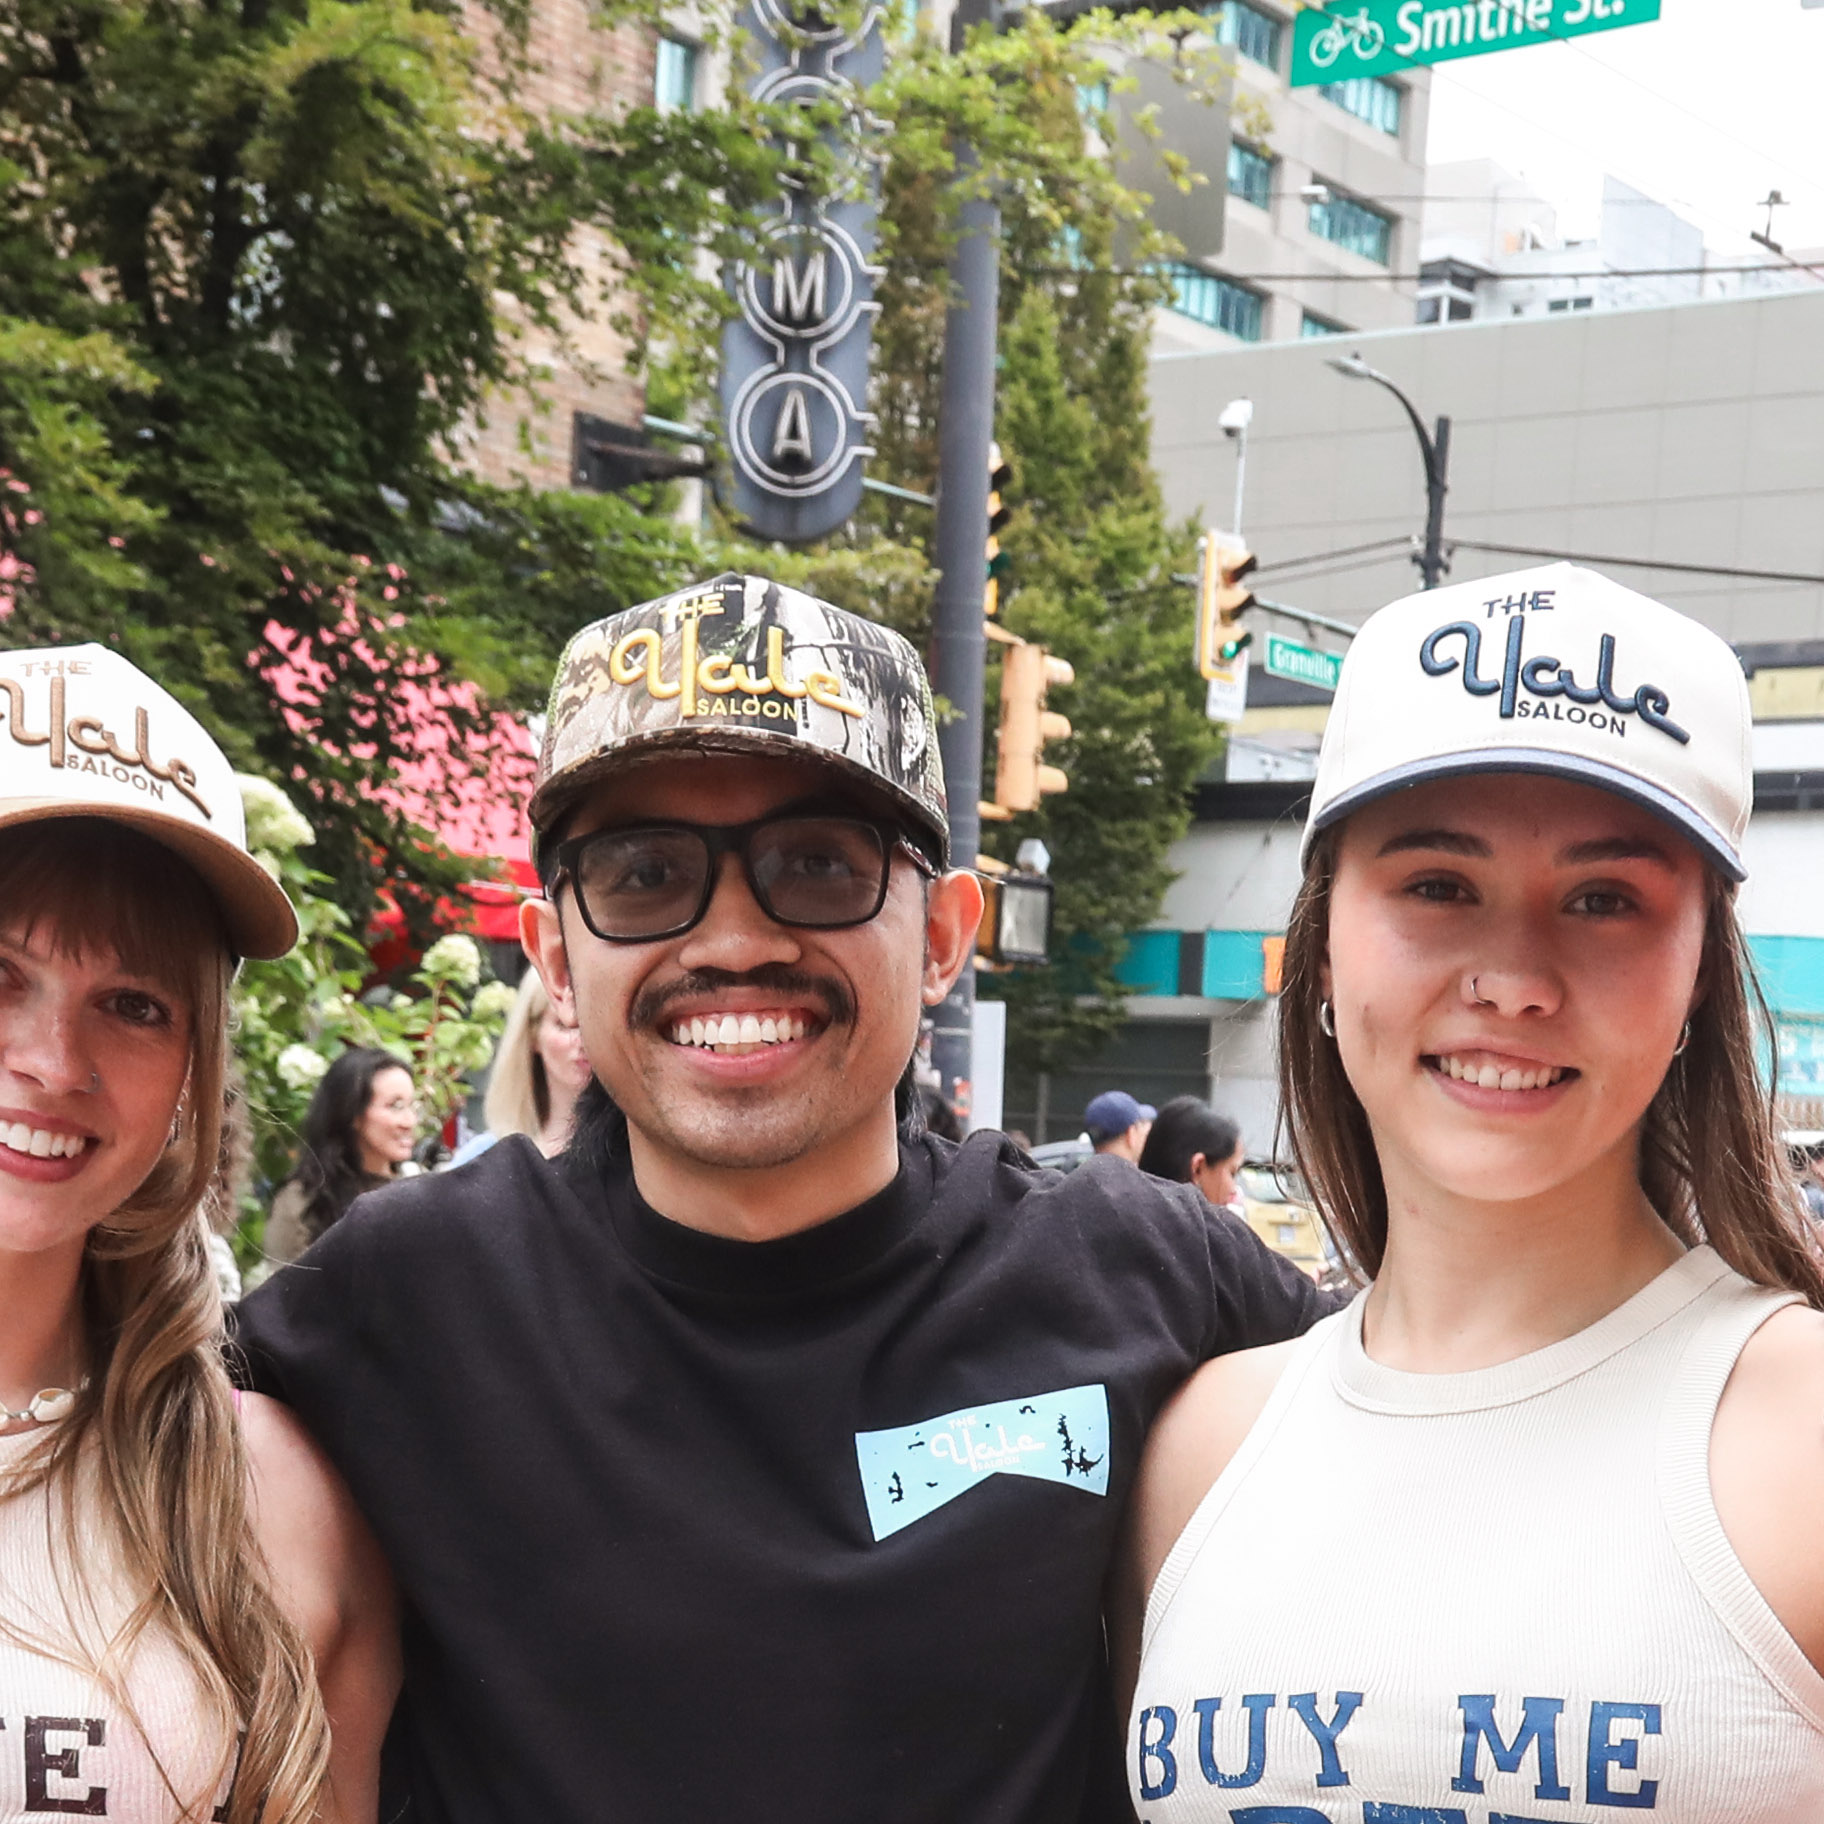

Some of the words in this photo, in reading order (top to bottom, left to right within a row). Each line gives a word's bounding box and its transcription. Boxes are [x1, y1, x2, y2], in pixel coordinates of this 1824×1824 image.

[1393, 0, 1551, 55] Smithe
[658, 593, 725, 622] THE
[1482, 590, 1556, 619] THE
[18, 660, 93, 677] THE
[609, 618, 867, 719] Yale
[1274, 642, 1337, 681] Granville
[1419, 614, 1692, 746] Yale
[695, 698, 798, 722] SALOON
[1517, 699, 1627, 738] SALOON
[66, 754, 165, 801] SALOON
[947, 1414, 977, 1430] THE
[1138, 1690, 1364, 1802] BUY
[1451, 1692, 1663, 1810] ME
